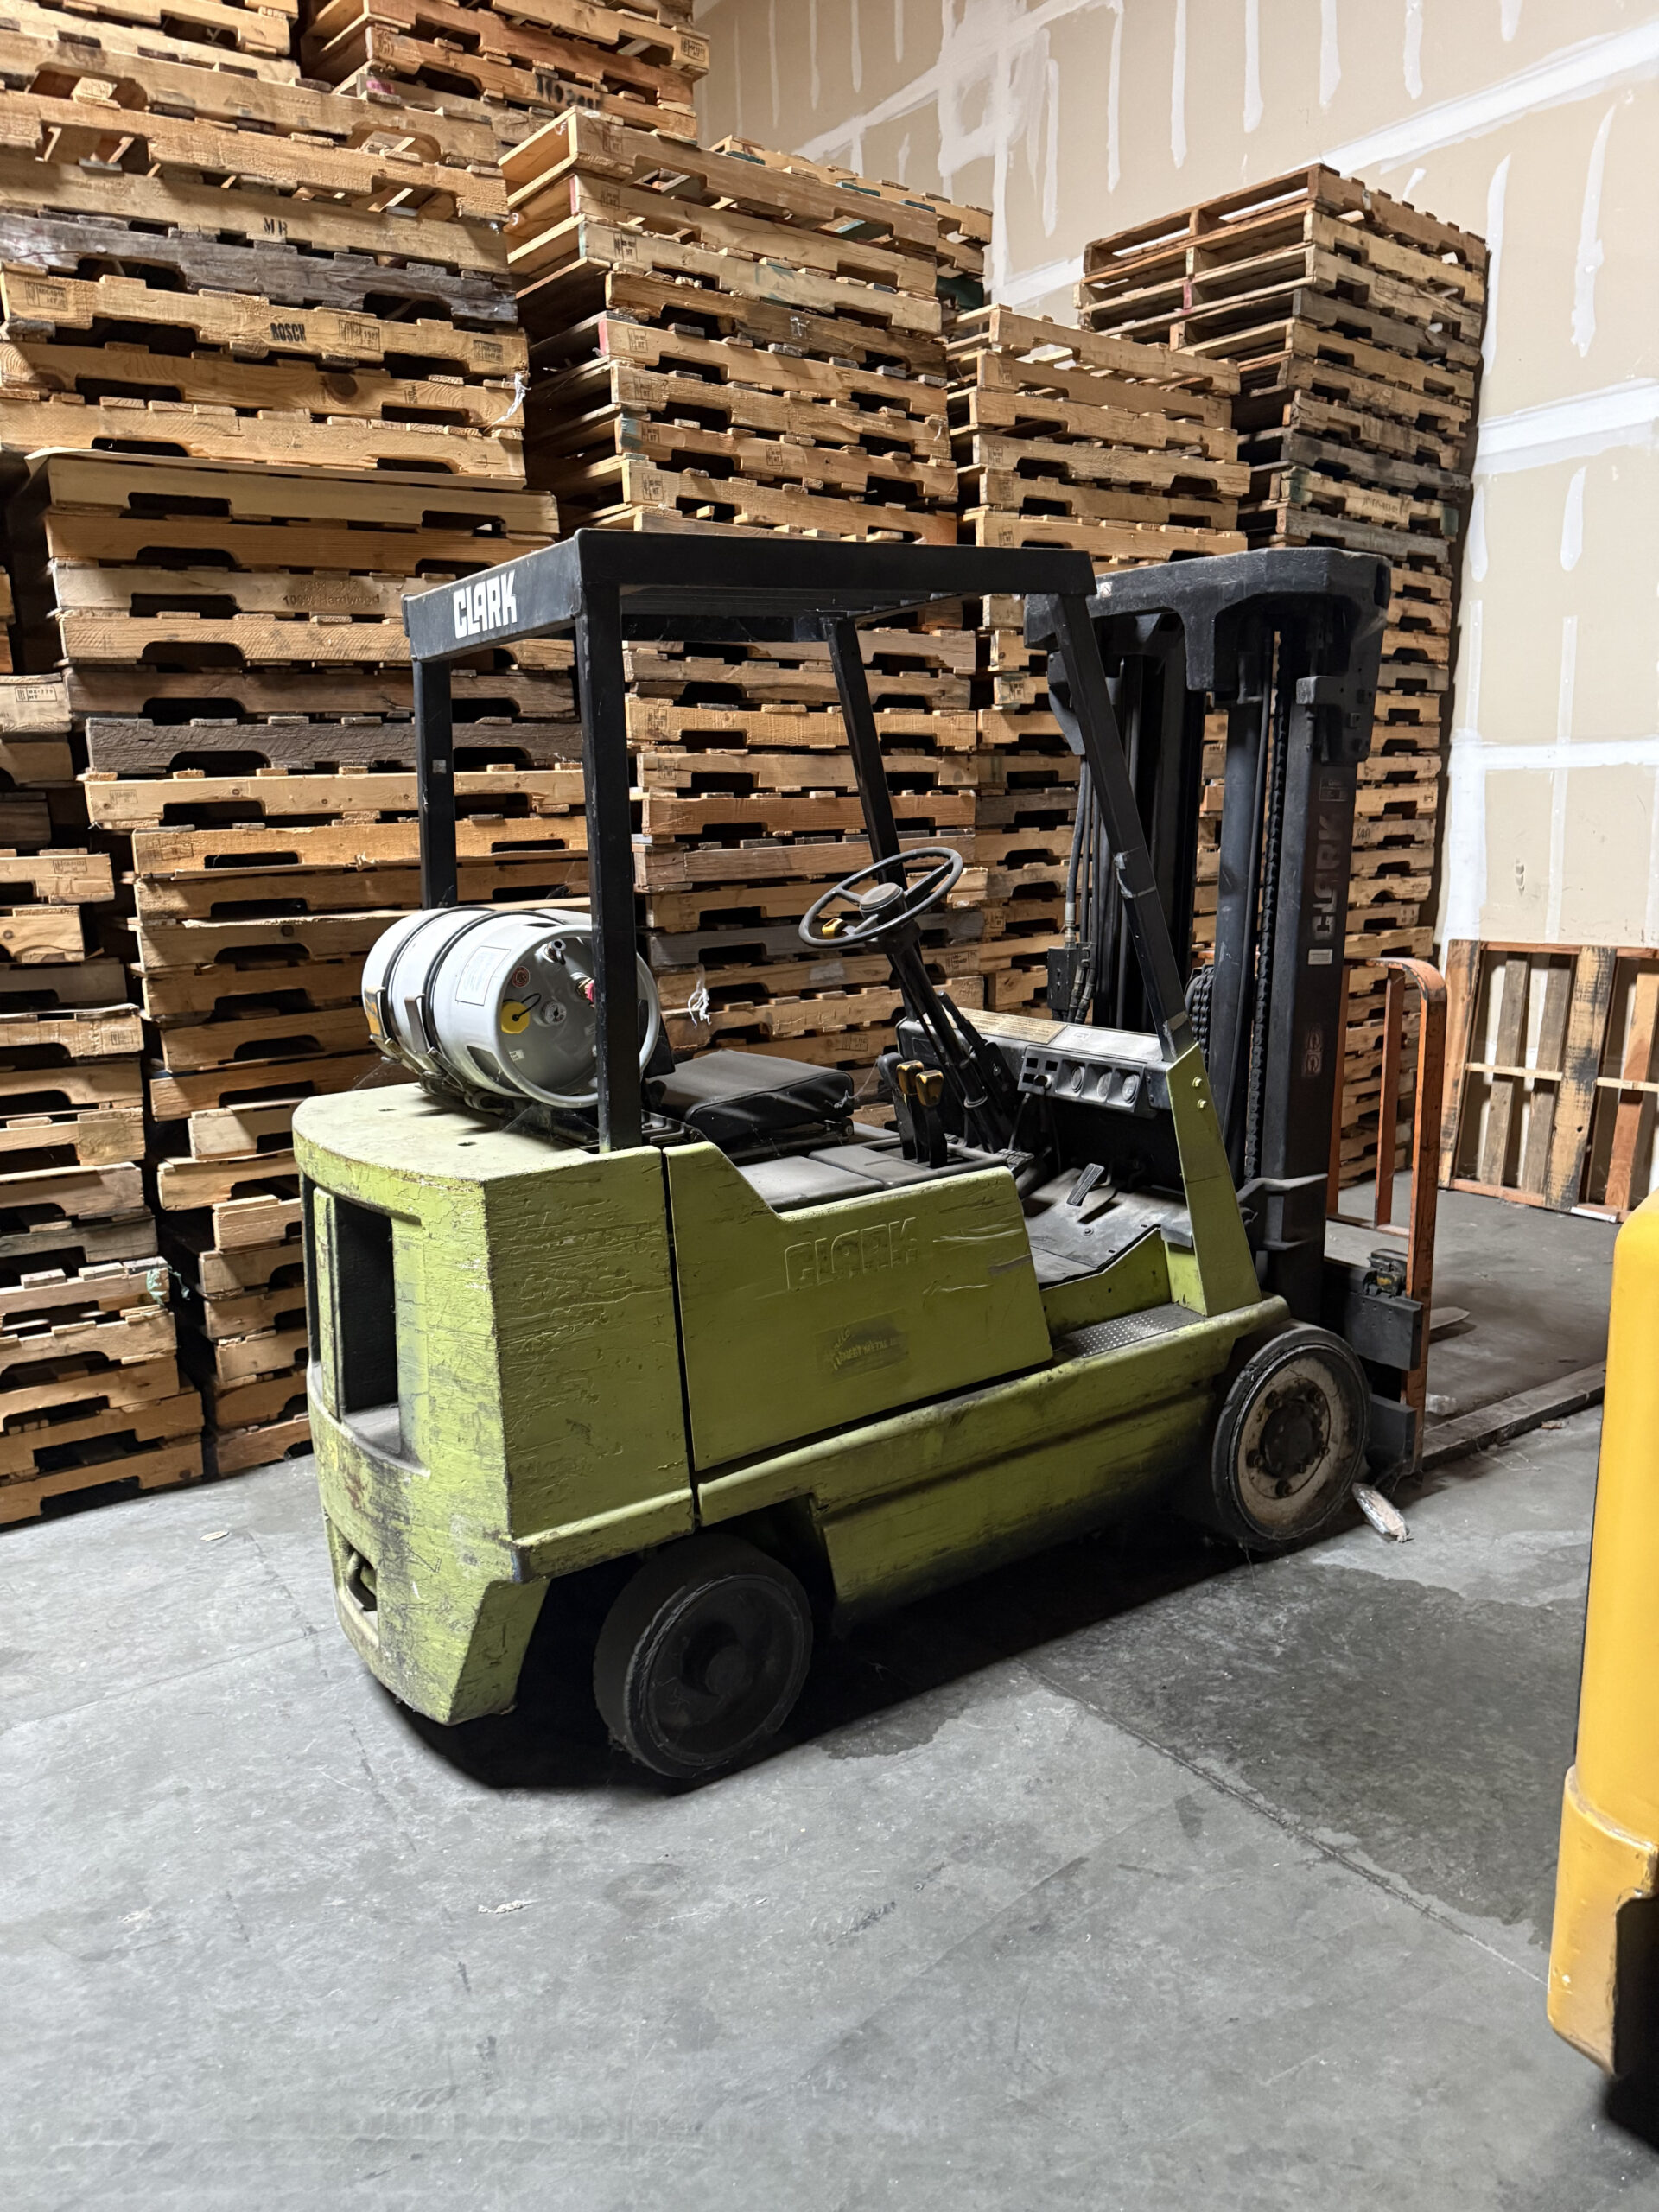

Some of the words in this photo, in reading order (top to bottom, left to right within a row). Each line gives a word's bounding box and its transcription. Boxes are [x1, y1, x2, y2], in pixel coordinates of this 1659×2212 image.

[270, 322, 306, 342] BOSCH
[319, 594, 380, 606] Hardwood
[454, 569, 518, 639] CLARK
[1311, 814, 1342, 941] CLARK
[785, 1217, 918, 1290] CLARK
